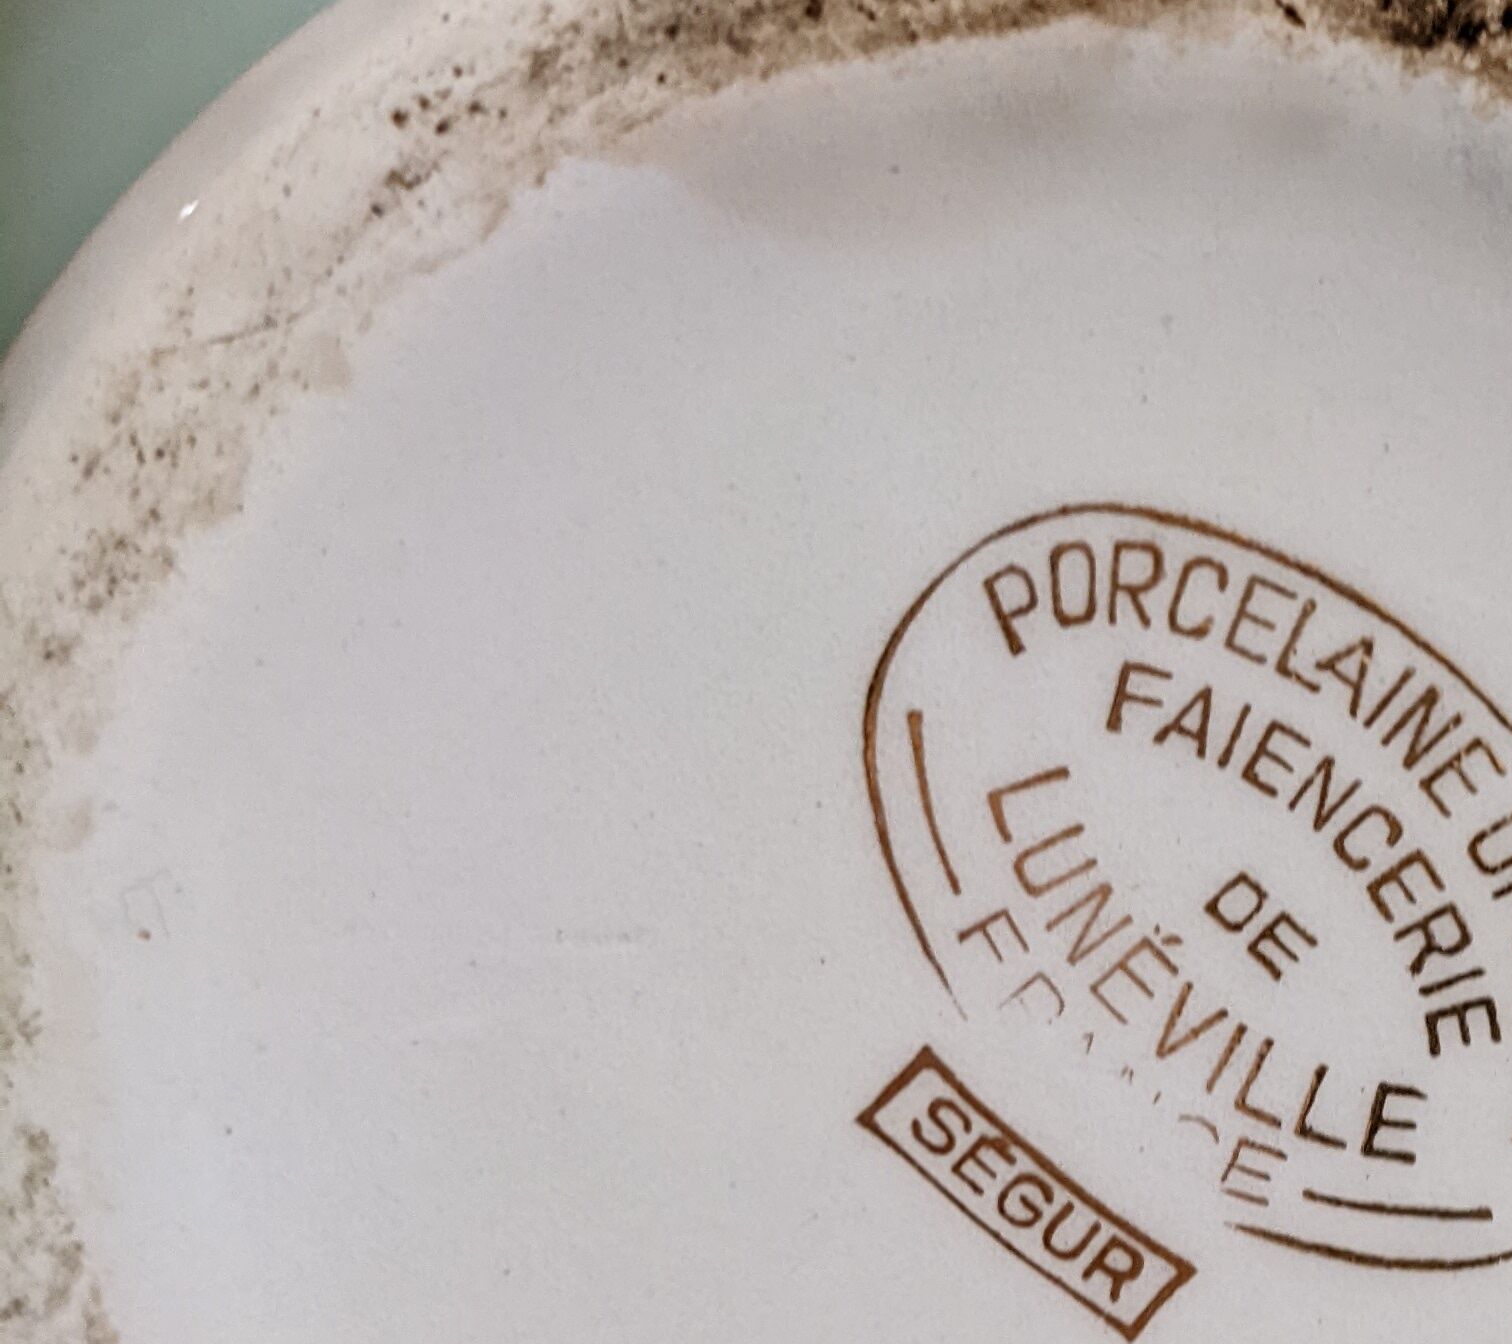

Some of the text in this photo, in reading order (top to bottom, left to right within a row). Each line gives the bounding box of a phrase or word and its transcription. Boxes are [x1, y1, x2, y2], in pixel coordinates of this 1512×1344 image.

[983, 540, 1506, 817] PORCELAINE
[986, 766, 1430, 1164] LUNÉVILLE
[1106, 660, 1501, 1057] FAIENCERIE
[1204, 871, 1318, 982] DE
